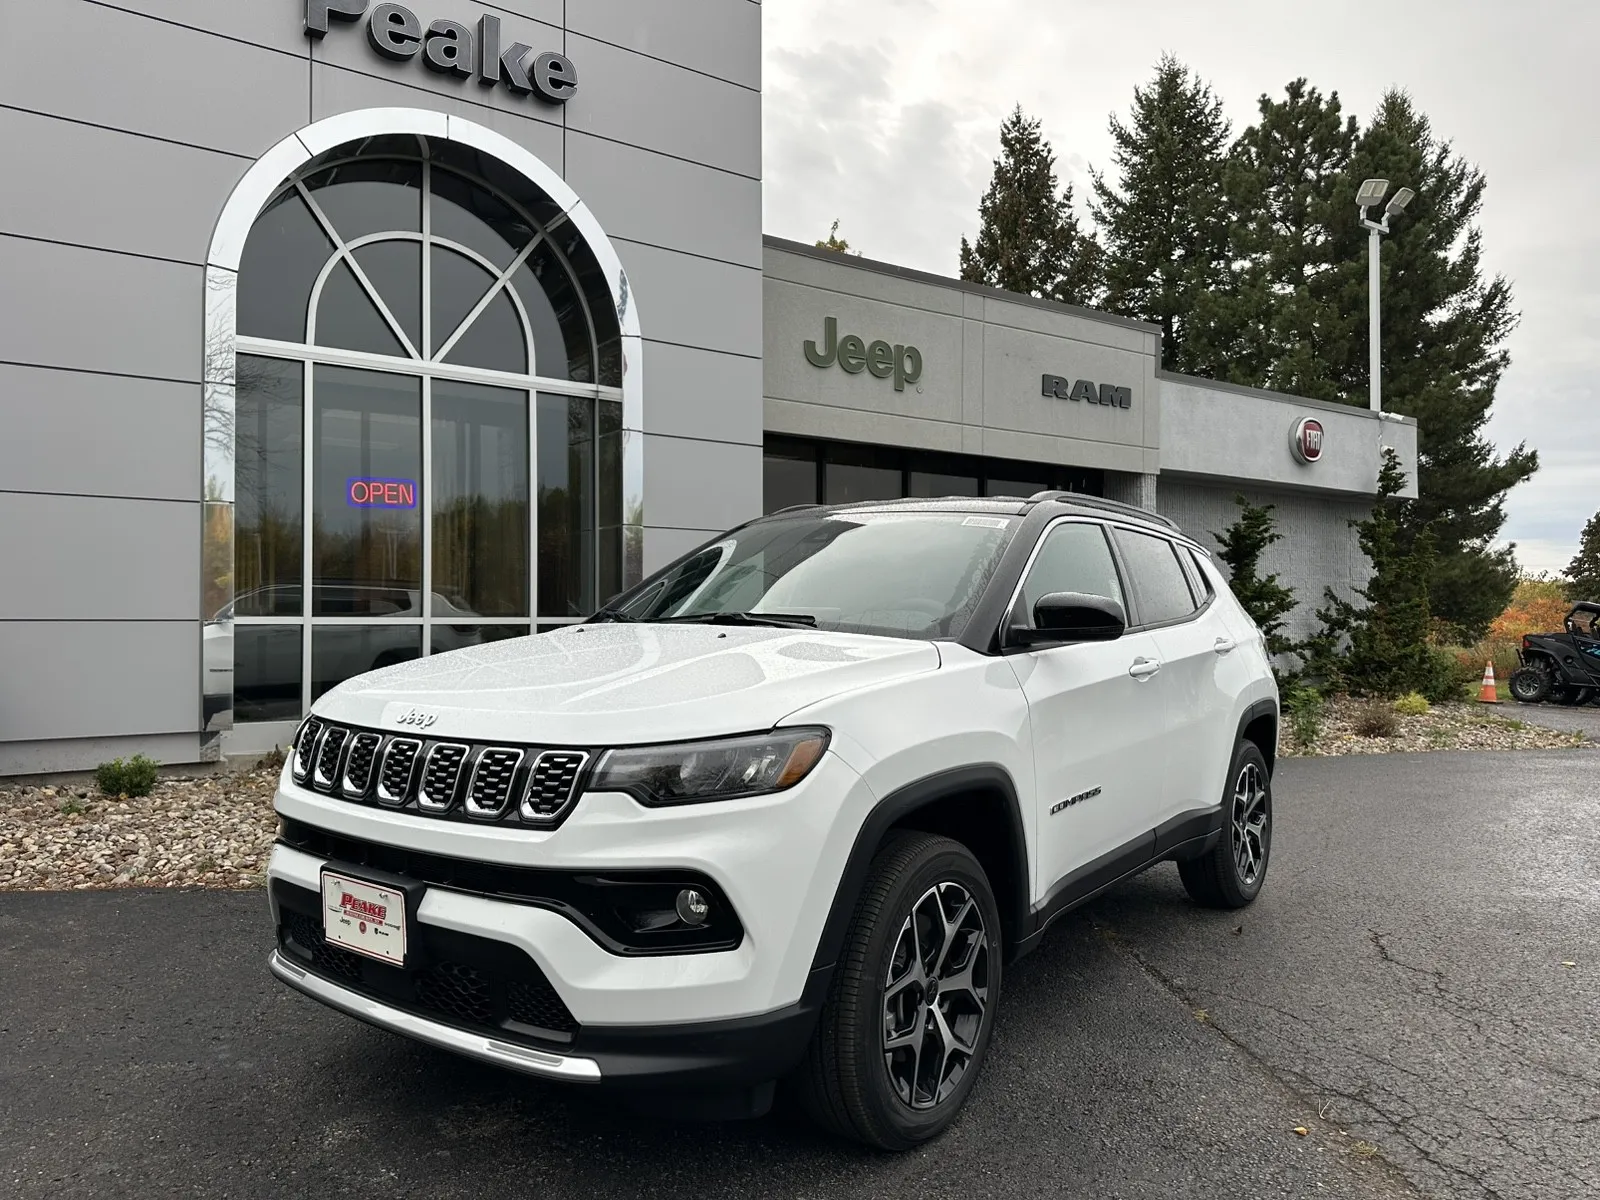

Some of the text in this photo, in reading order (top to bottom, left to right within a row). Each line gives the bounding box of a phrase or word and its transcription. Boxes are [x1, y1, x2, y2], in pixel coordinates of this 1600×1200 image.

[804, 316, 922, 391] Jeep
[1042, 374, 1131, 409] RAM
[351, 481, 413, 504] OPEN
[396, 707, 439, 729] Jeep
[1050, 785, 1101, 816] COMPASS
[339, 892, 387, 920] PEAKE
